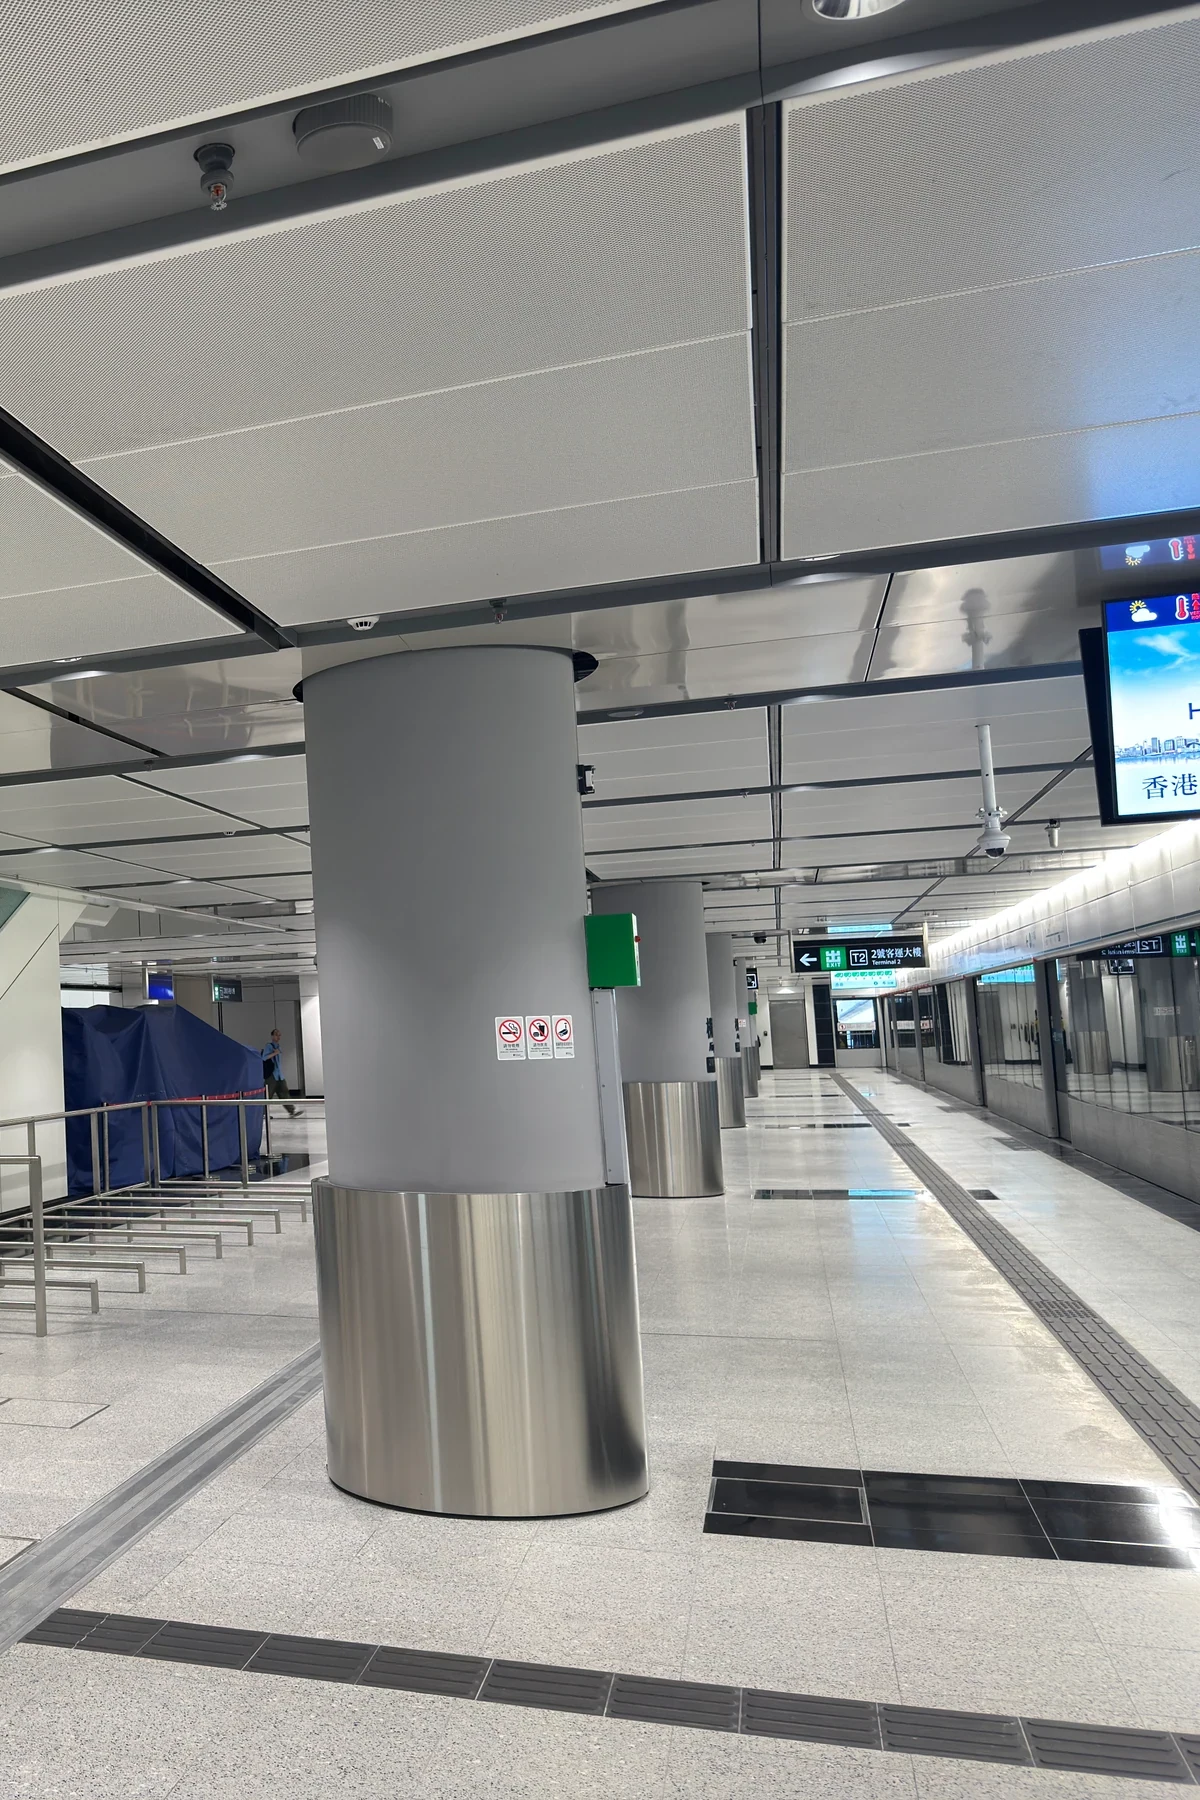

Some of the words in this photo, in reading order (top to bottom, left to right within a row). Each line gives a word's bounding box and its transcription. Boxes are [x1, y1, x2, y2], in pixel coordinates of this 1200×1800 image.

[1142, 773, 1198, 799] 香港
[852, 953, 867, 963] T2
[871, 947, 922, 959] 2號客運大樓
